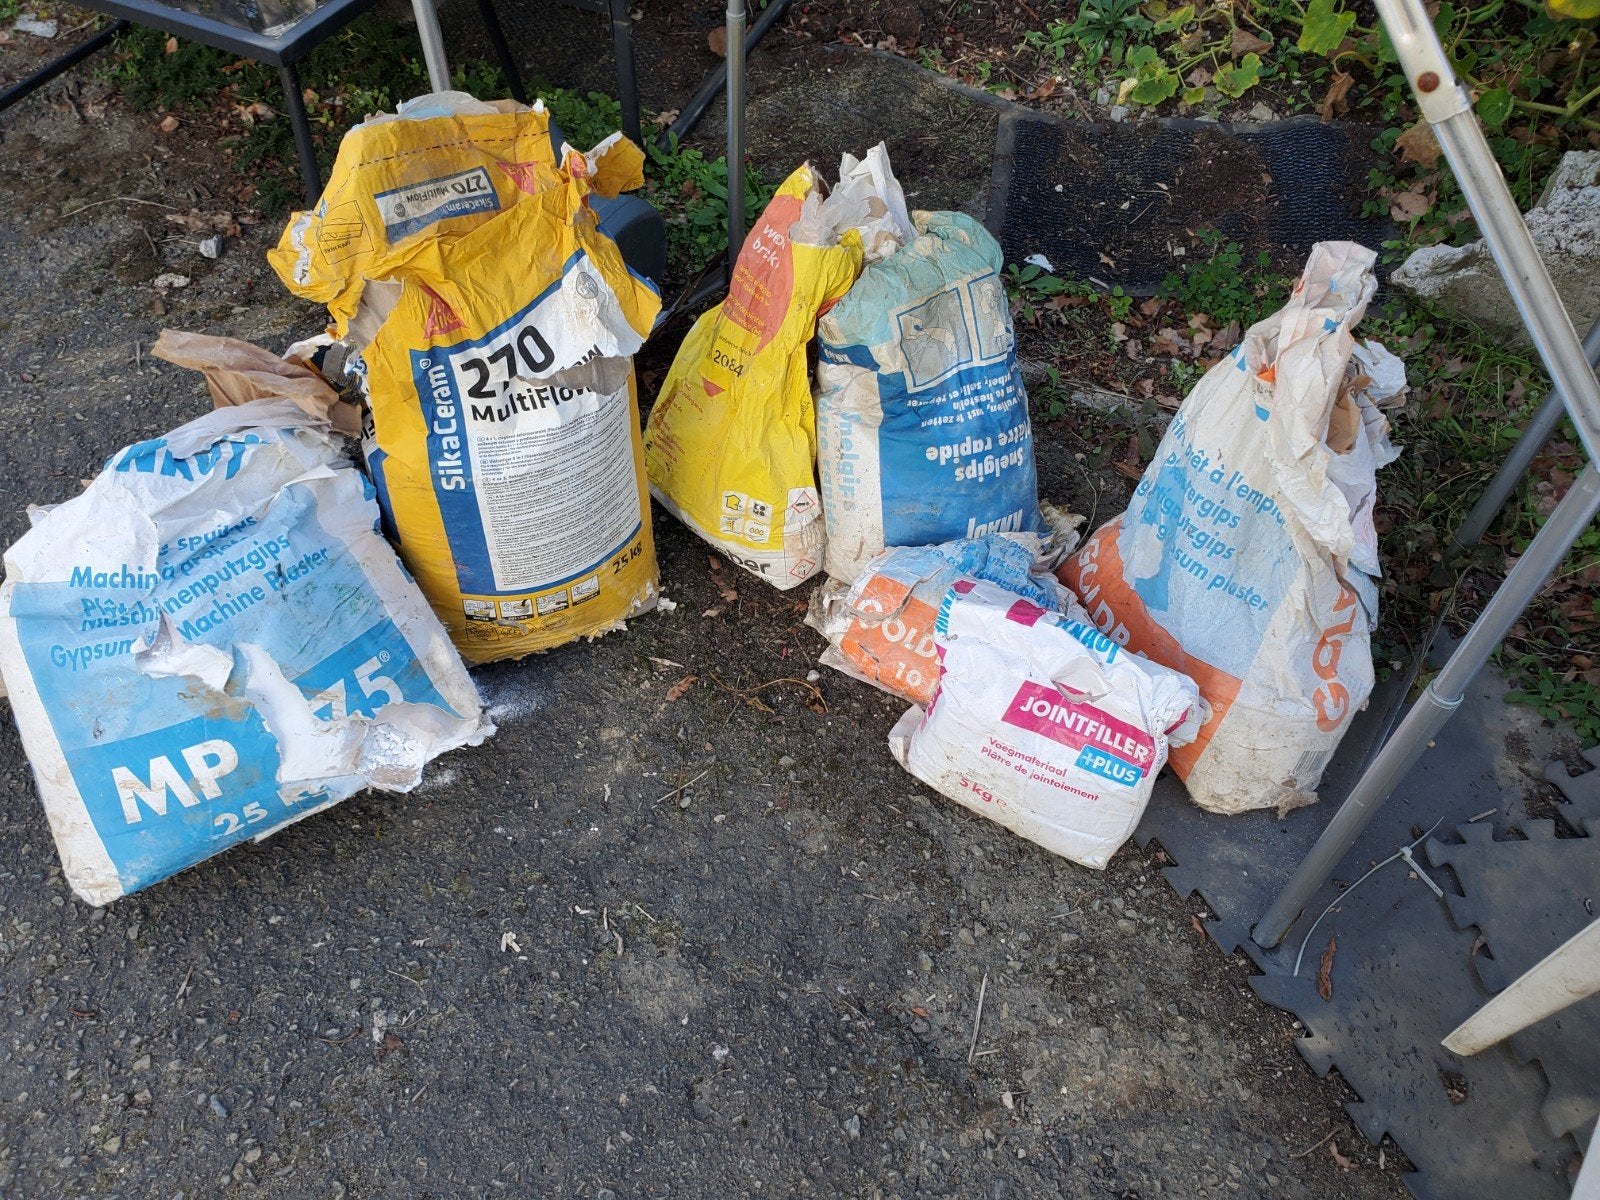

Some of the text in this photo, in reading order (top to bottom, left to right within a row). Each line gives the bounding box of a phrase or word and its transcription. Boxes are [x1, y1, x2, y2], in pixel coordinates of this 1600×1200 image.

[406, 175, 488, 203] 270 MultiFlow
[445, 197, 494, 212] SikaCeram
[460, 326, 555, 399] 270
[713, 350, 744, 378] 2084
[428, 365, 466, 491] SikaCeram
[921, 415, 955, 428] zetten
[925, 436, 992, 465] rapide
[954, 447, 1023, 482] Snelgips
[1209, 463, 1225, 485] à
[161, 562, 175, 581] à
[263, 545, 329, 591] Plaster
[612, 541, 643, 575] 25 kg
[1206, 574, 1269, 611] plaster
[895, 661, 922, 687] 10
[1020, 696, 1151, 762] JOINTFILLER
[981, 745, 1100, 802] Plâtre de jointoiement
[989, 737, 1067, 777] Voegmateriaal
[111, 738, 239, 824] MP
[959, 776, 969, 788] 5
[971, 782, 993, 803] kg
[214, 801, 268, 837] 25
